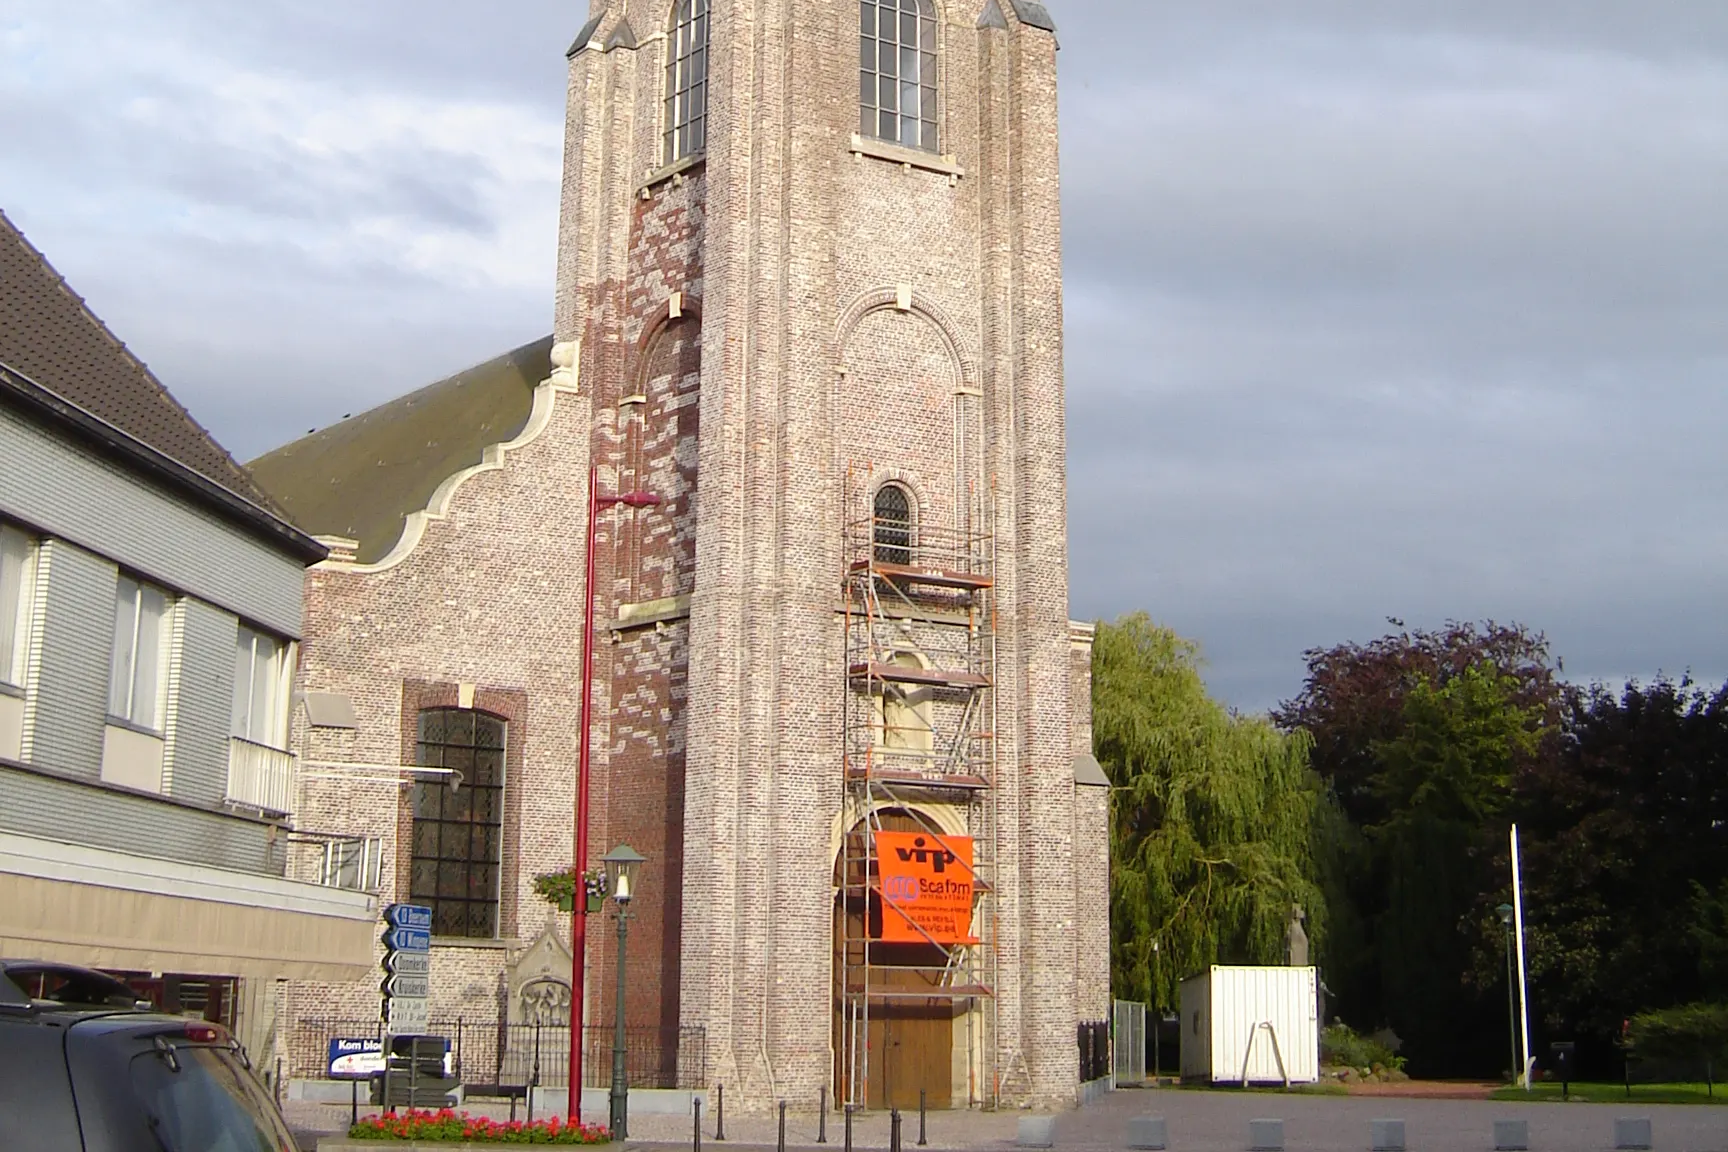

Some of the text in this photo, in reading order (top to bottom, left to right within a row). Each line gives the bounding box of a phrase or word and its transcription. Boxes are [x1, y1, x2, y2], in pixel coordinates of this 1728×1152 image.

[895, 837, 955, 873] vip
[919, 878, 970, 895] Scafom
[338, 1039, 362, 1050] Kom
